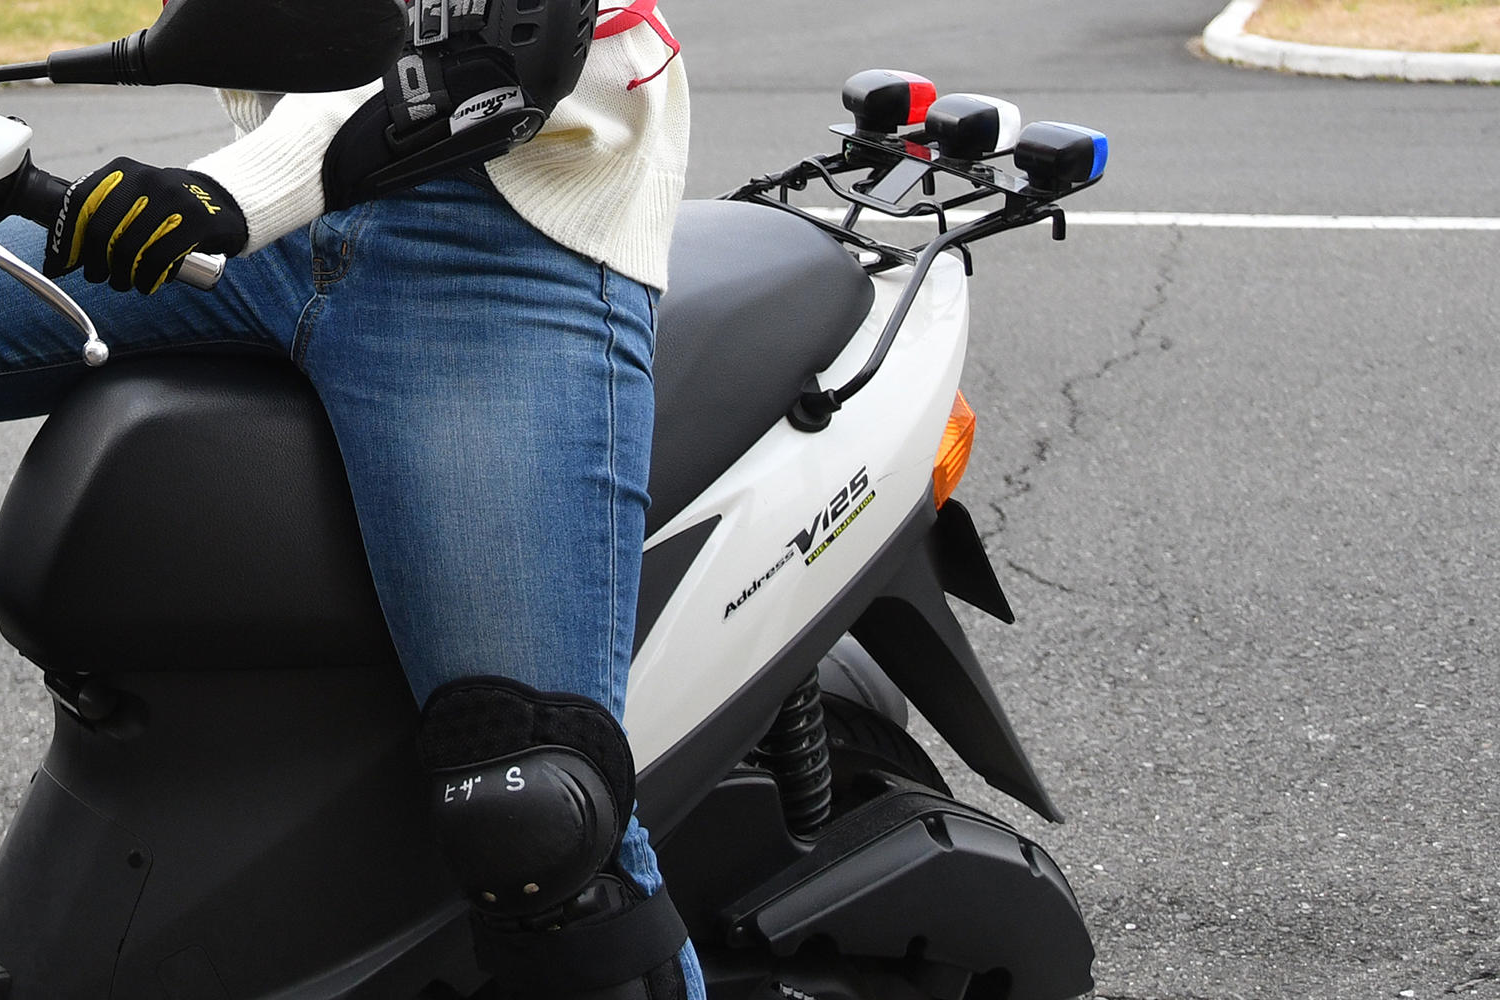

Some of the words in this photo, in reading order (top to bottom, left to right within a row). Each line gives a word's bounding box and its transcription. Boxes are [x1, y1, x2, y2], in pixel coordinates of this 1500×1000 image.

[723, 548, 795, 619] Address
[786, 465, 869, 555] V125
[506, 766, 525, 791] S
